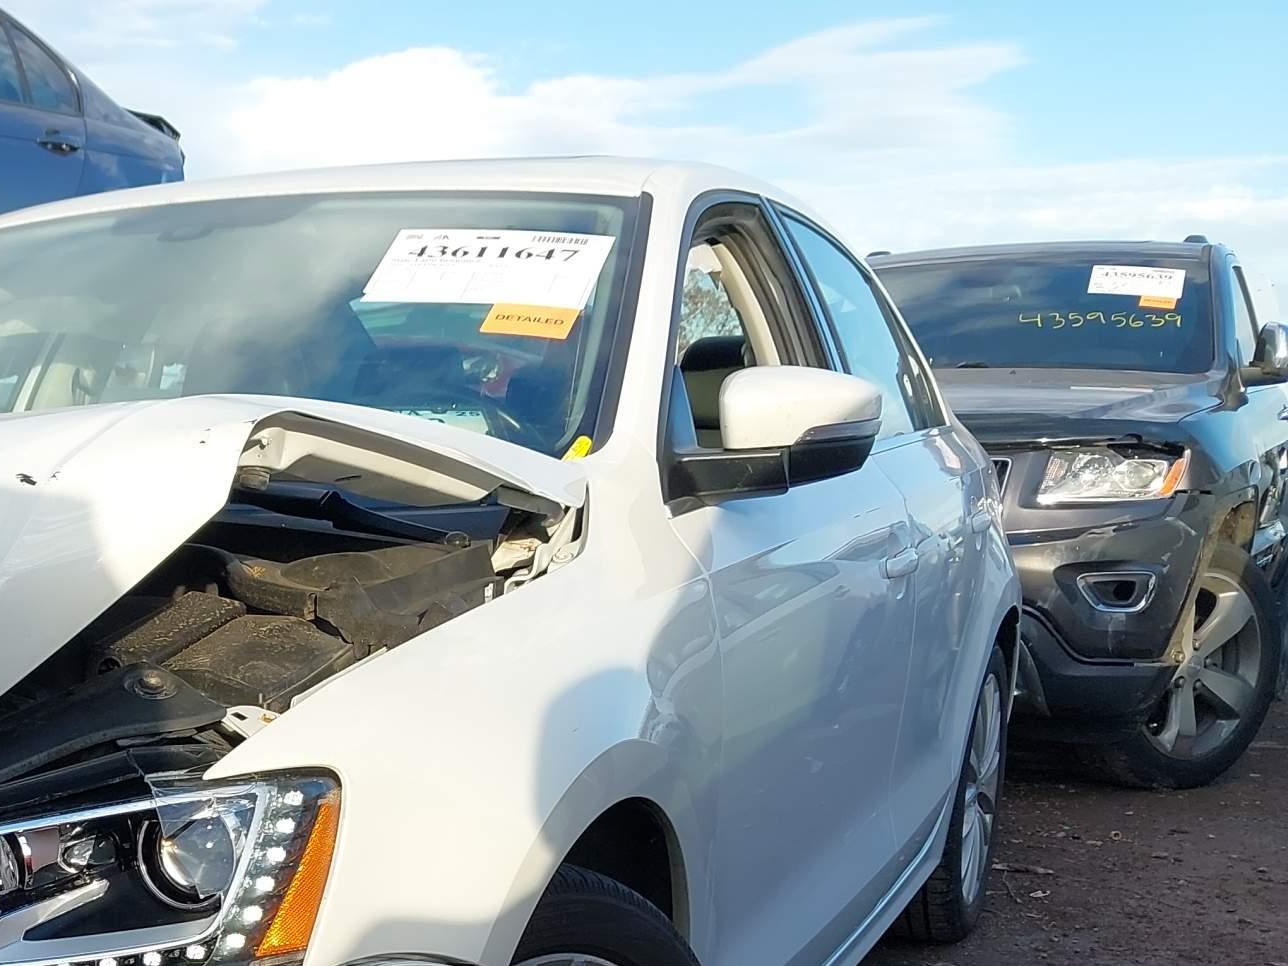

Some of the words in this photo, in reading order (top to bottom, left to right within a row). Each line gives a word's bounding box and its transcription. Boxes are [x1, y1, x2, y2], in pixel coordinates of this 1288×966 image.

[408, 244, 579, 262] 43611647
[494, 313, 565, 326] DETAILED
[1018, 311, 1183, 329] 43595639
